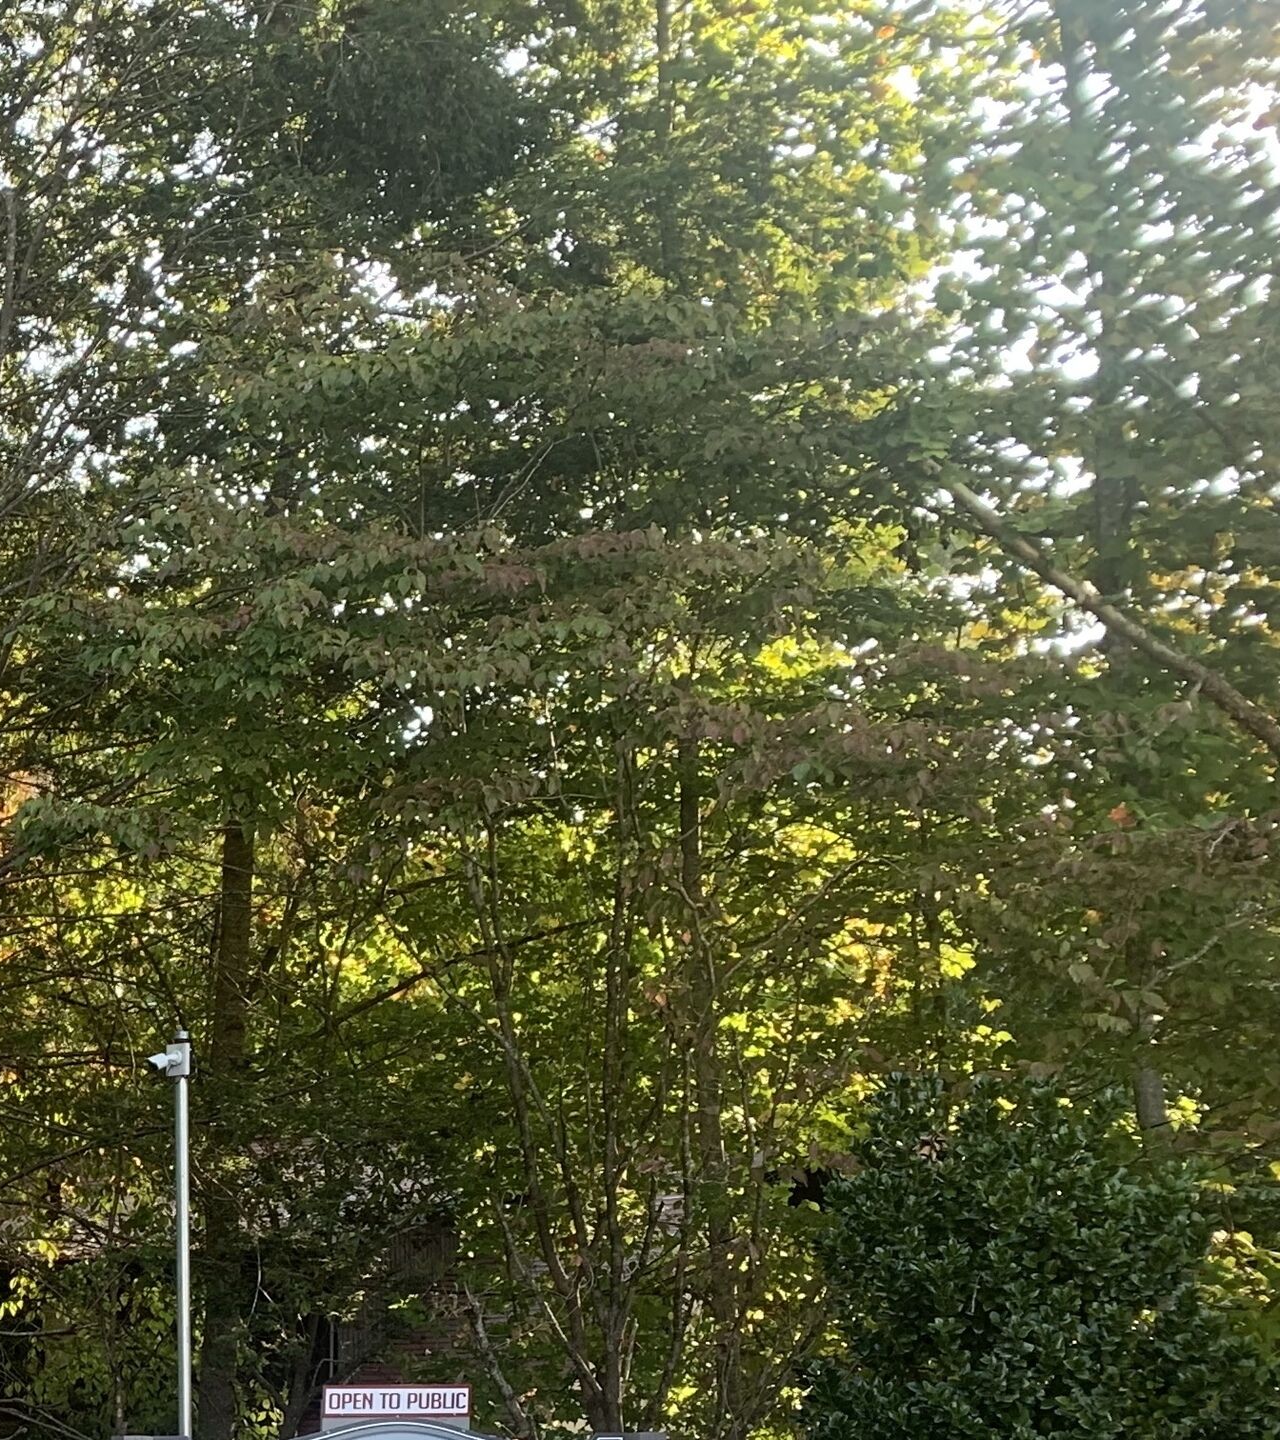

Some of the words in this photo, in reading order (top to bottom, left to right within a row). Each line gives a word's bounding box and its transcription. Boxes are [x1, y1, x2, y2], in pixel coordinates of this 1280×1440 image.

[329, 1392, 373, 1410] OPEN
[379, 1392, 401, 1410] TO
[407, 1392, 467, 1410] PUBLIC
